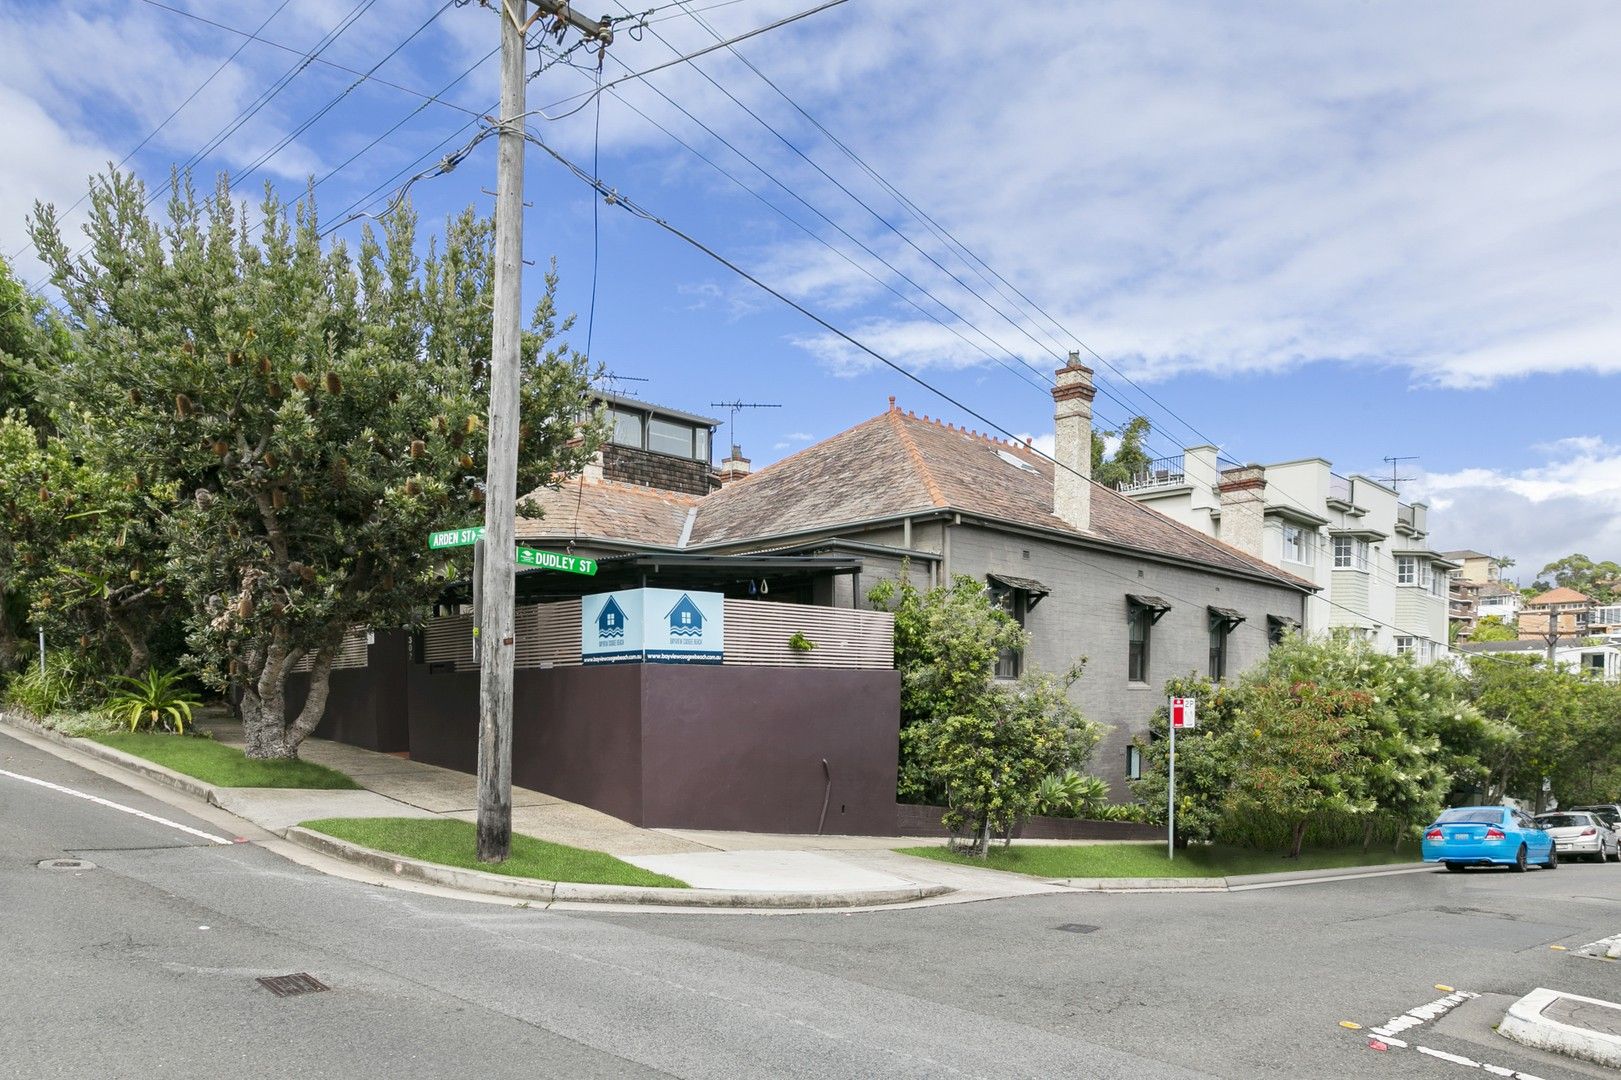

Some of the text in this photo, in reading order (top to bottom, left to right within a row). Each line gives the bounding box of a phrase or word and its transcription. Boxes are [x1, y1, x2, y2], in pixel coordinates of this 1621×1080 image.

[433, 530, 472, 547] ARDEN ST
[536, 552, 592, 573] DUDLEY ST
